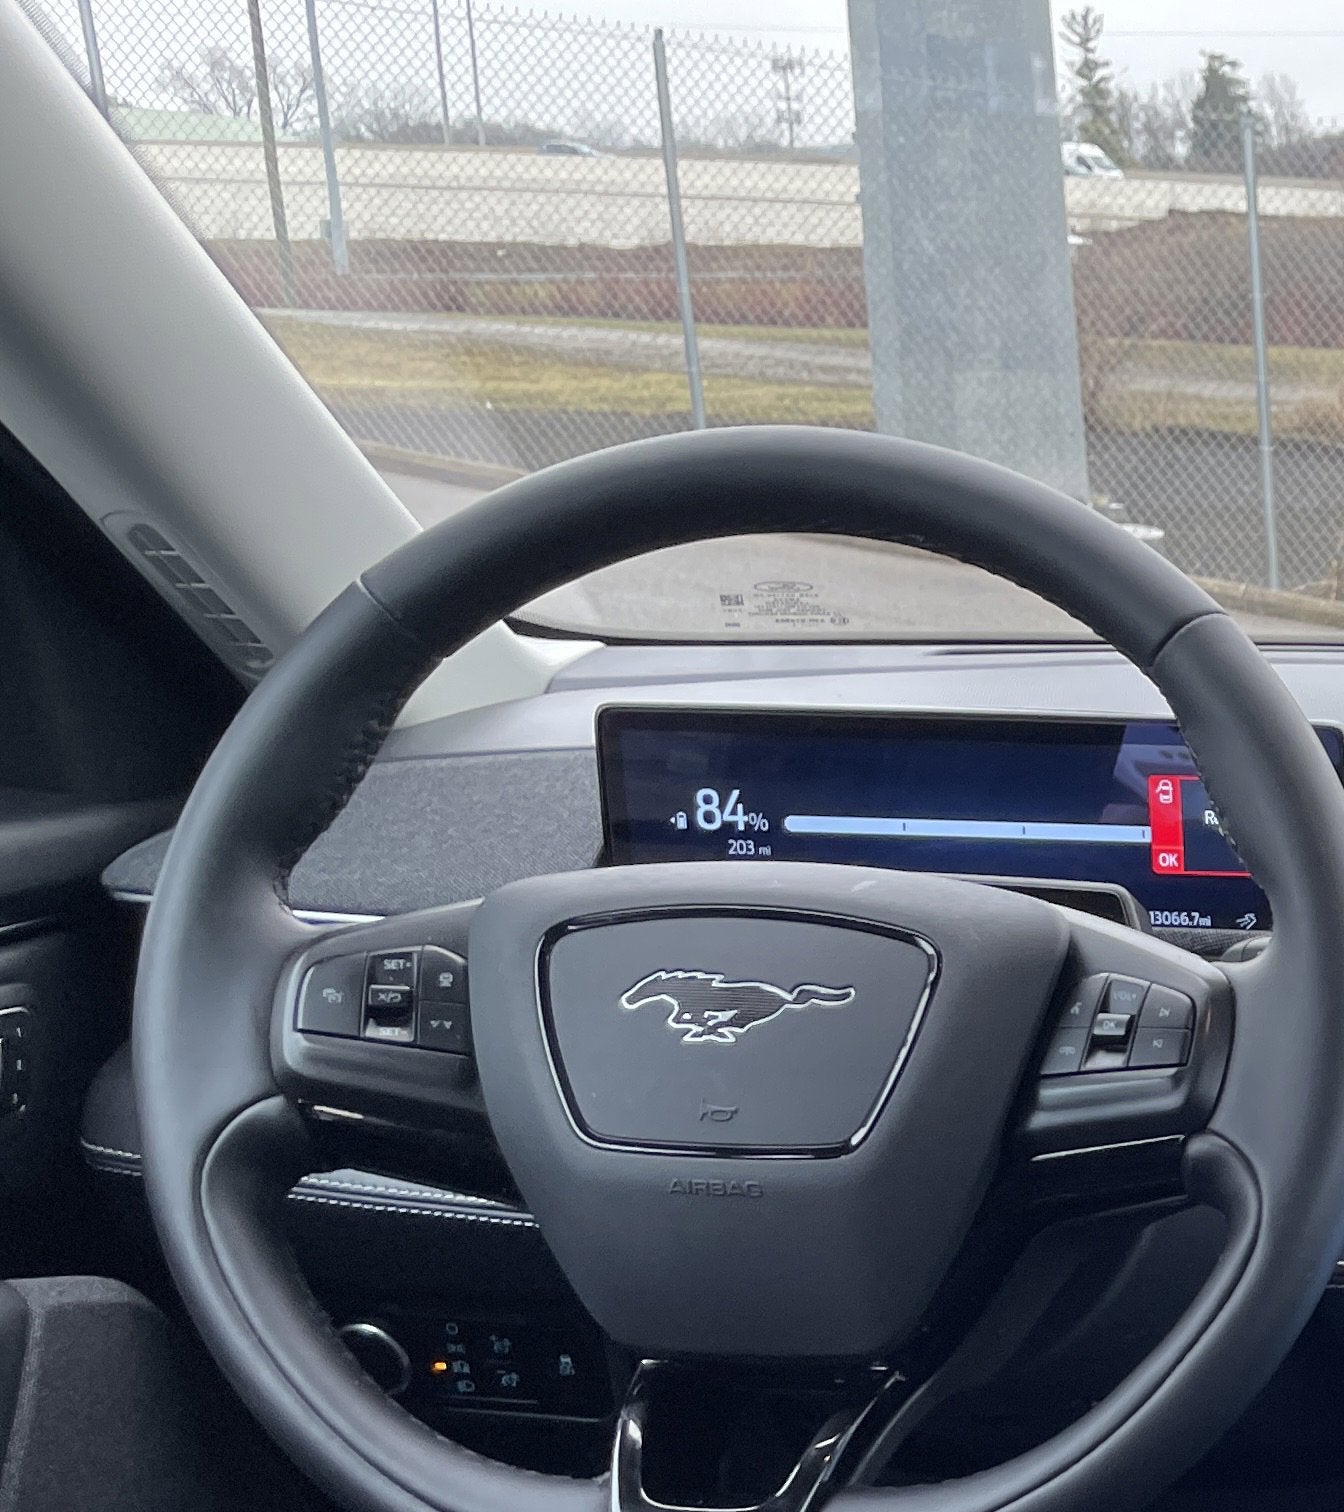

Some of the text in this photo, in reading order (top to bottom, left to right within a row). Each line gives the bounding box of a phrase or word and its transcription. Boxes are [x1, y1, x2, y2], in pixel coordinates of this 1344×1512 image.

[728, 839, 771, 855] 203 mi
[1159, 853, 1179, 867] OK
